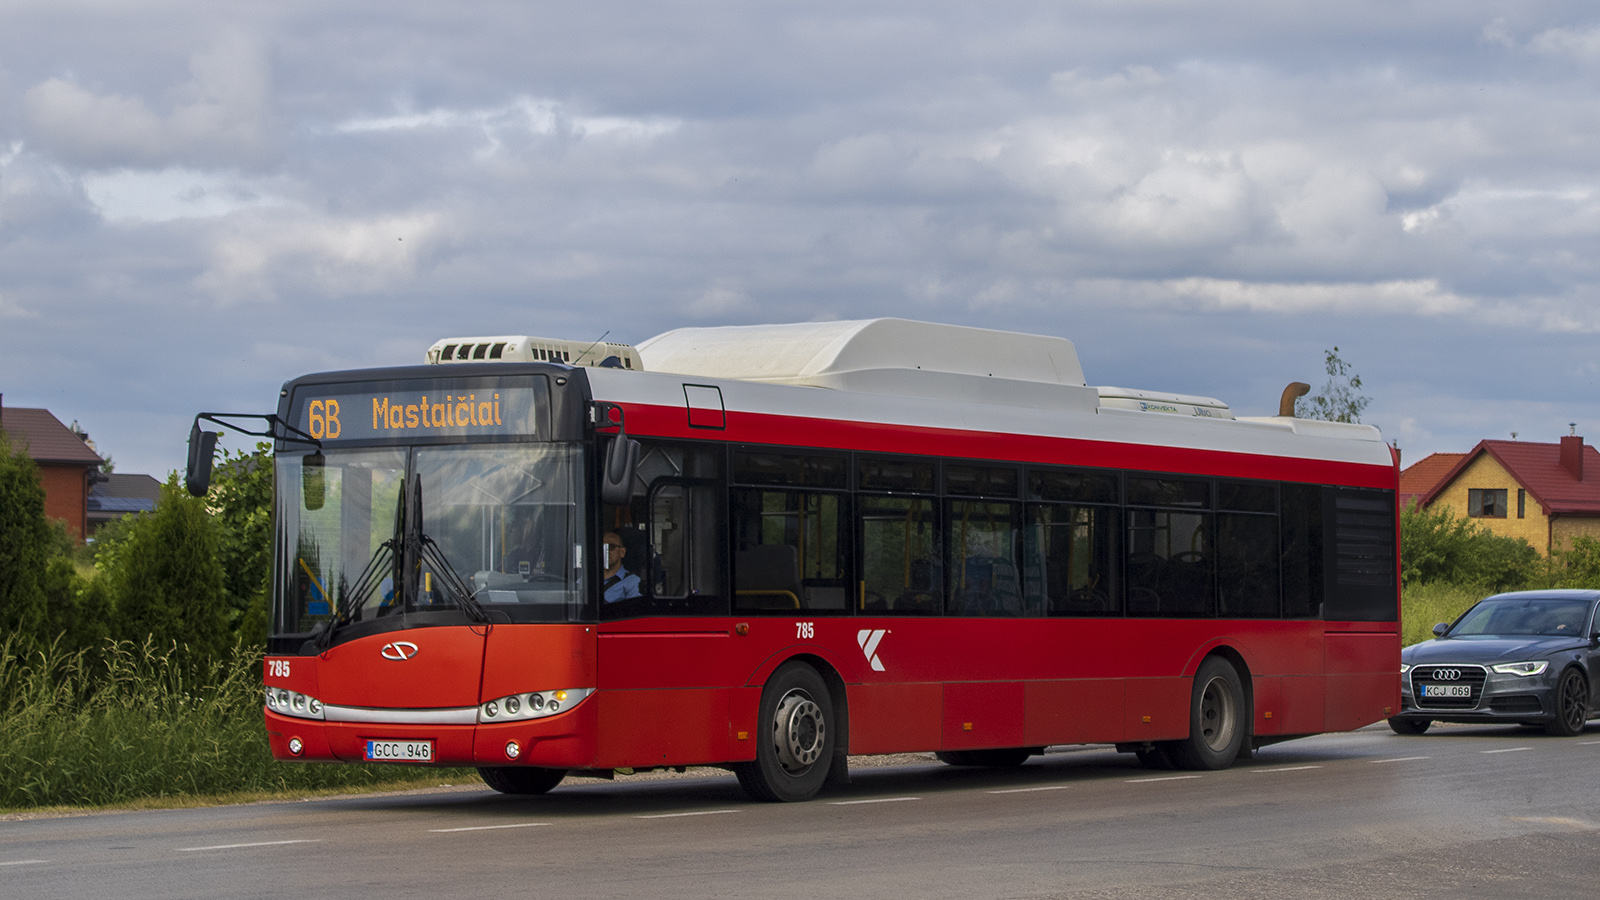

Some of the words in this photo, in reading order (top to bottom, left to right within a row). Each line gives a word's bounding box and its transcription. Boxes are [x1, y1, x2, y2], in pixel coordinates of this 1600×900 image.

[308, 399, 341, 439] 6B
[372, 393, 502, 430] Mastaičiai
[796, 622, 814, 639] 785
[268, 660, 290, 677] 785
[1426, 686, 1447, 696] KCJ
[1451, 686, 1470, 696] 069
[374, 743, 399, 757] GCC
[407, 743, 429, 758] 946
